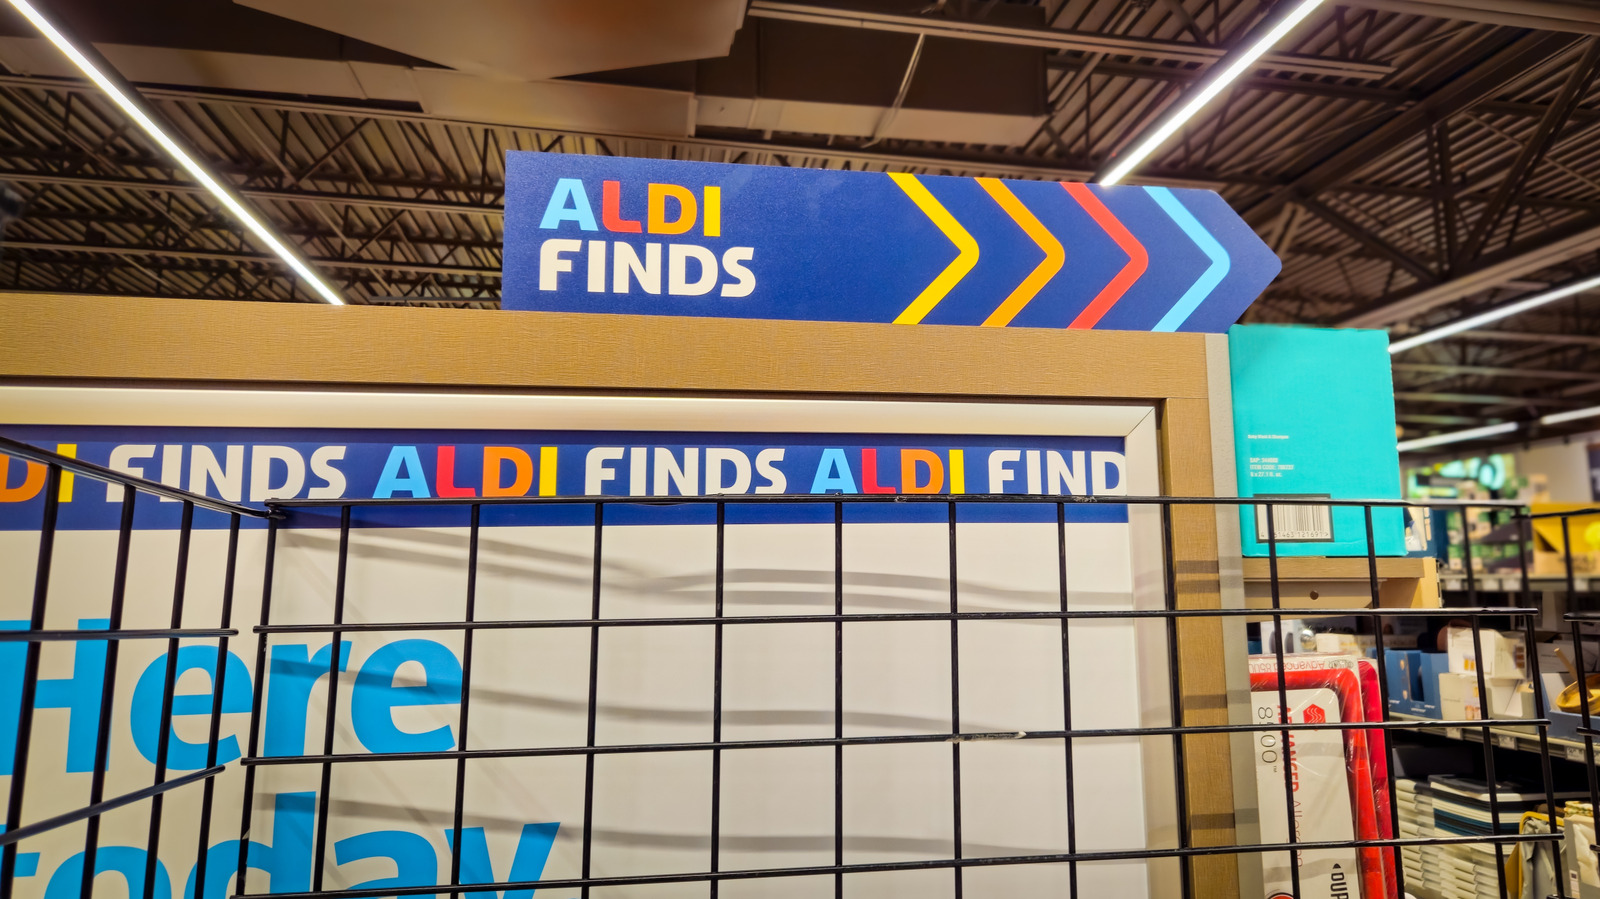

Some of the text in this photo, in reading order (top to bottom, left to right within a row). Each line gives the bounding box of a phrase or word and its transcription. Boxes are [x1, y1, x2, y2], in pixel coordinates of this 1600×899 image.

[539, 178, 721, 237] ALDI
[539, 239, 756, 298] FINDS
[106, 444, 347, 503] FINDS
[372, 445, 558, 498] ALDI
[585, 446, 788, 497] FINDS
[810, 448, 965, 495] ALDI
[988, 449, 1127, 497] FIND
[0, 618, 463, 776] Here
